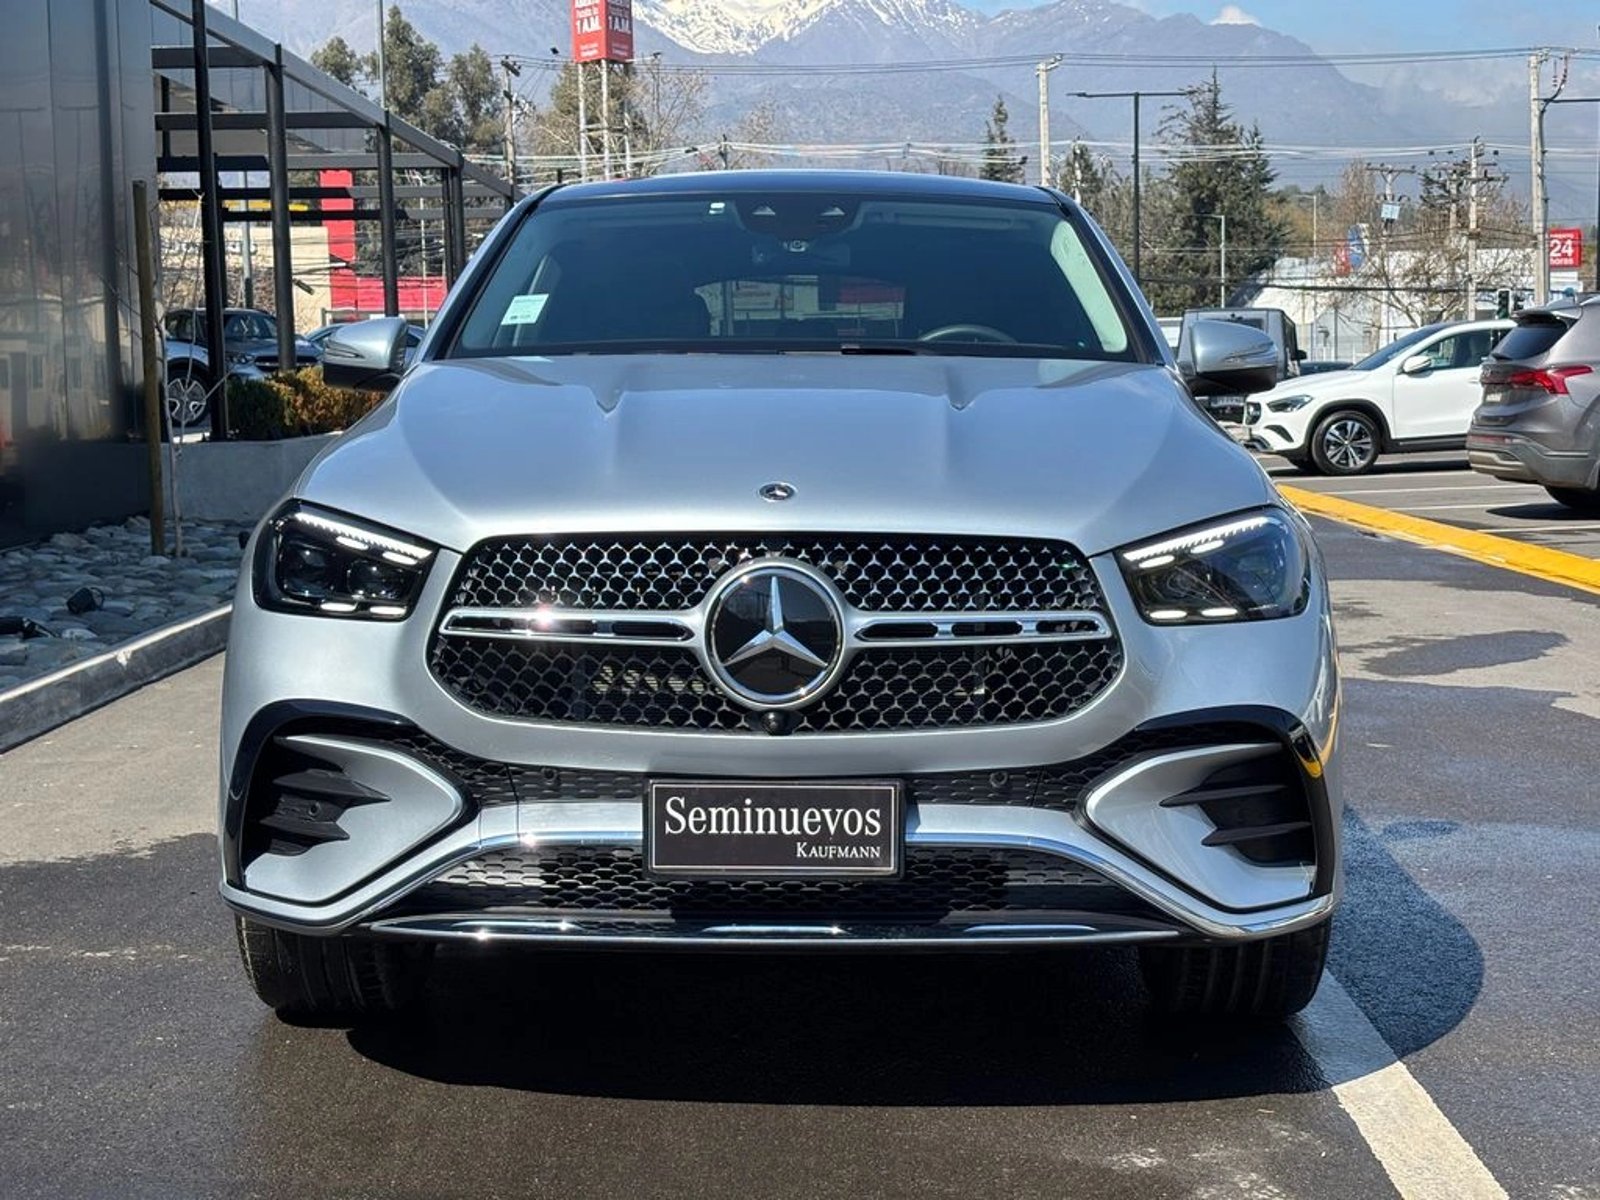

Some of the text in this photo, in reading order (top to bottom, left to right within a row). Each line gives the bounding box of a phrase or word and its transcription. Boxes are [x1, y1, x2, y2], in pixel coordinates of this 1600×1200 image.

[1550, 239, 1573, 257] 24
[665, 796, 881, 836] Seminuevos
[796, 842, 881, 859] KAUFMANN
